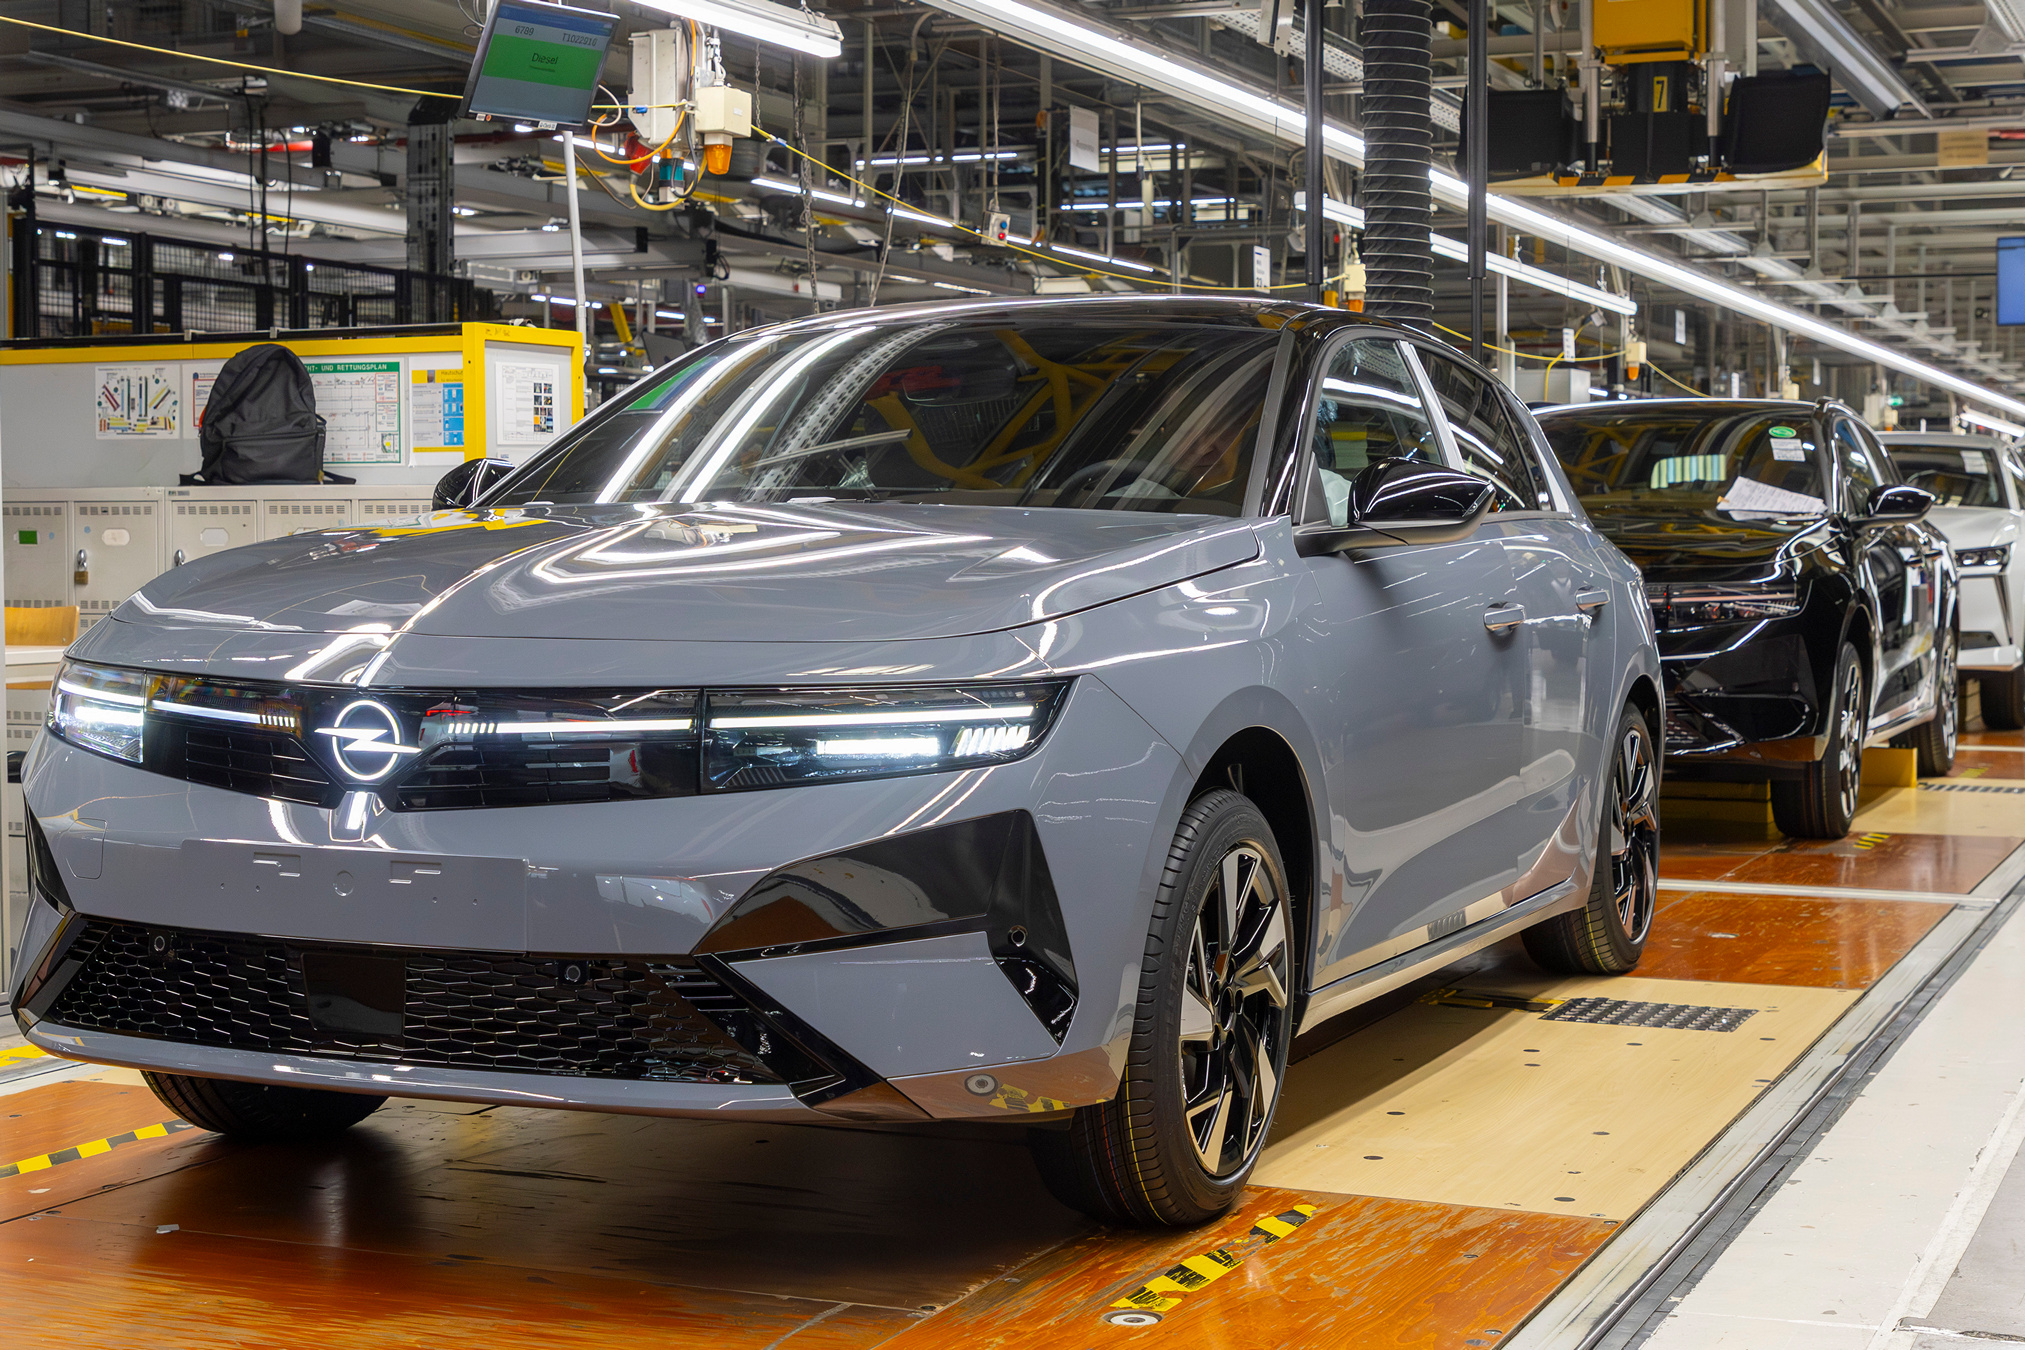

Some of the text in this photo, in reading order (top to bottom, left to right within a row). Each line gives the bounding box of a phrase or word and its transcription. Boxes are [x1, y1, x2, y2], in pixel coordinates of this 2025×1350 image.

[515, 25, 535, 36] 6789
[531, 52, 558, 64] Diesel
[1656, 80, 1664, 109] 7
[321, 364, 334, 372] UND
[336, 363, 388, 371] RETTUNGSPLAN
